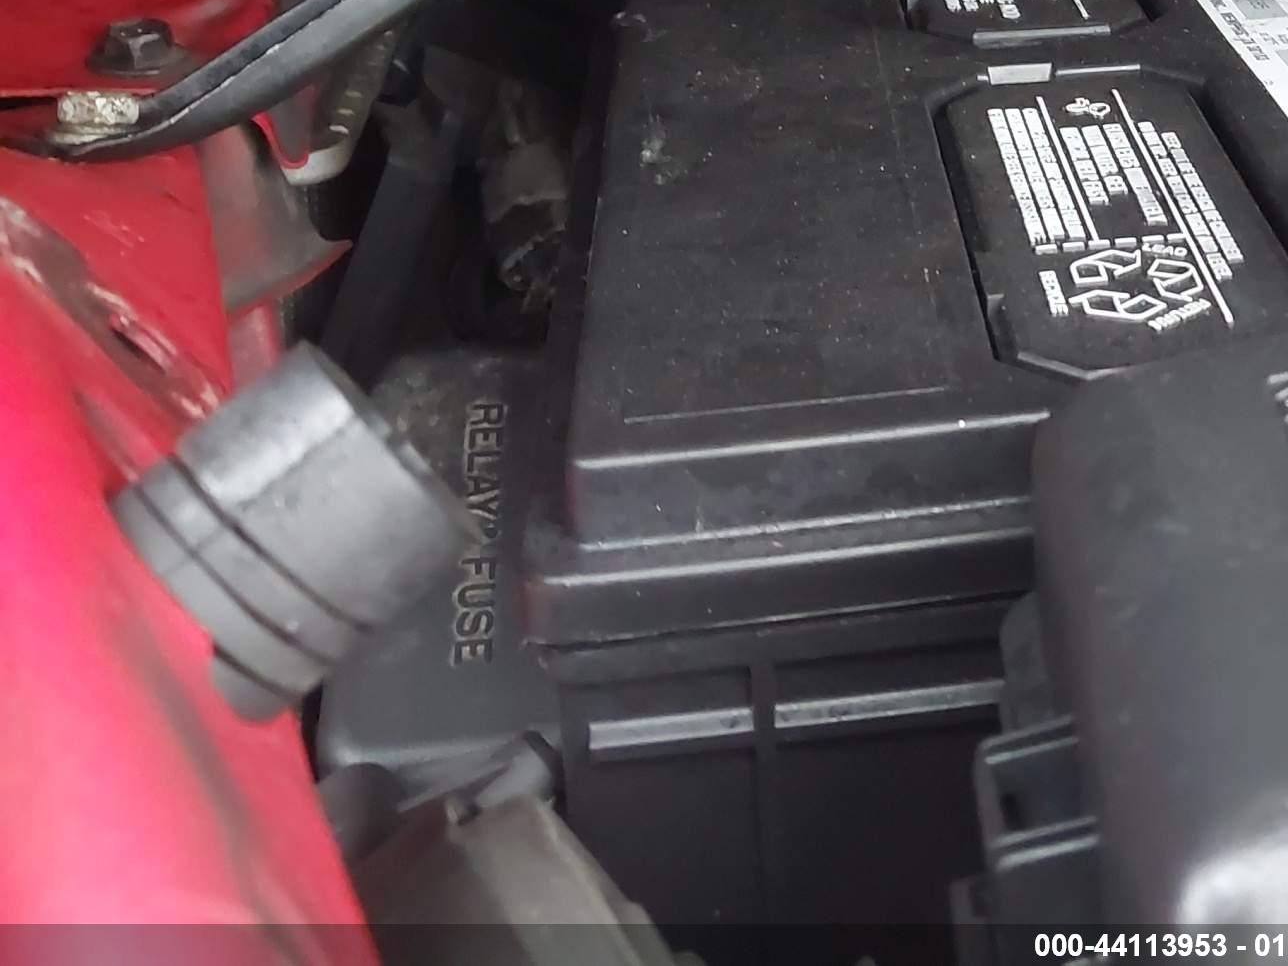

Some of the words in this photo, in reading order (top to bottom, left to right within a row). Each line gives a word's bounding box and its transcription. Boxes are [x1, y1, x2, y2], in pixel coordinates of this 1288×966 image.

[1141, 242, 1188, 258] LEAD
[464, 401, 508, 524] RELAY
[449, 556, 496, 669] FUSE
